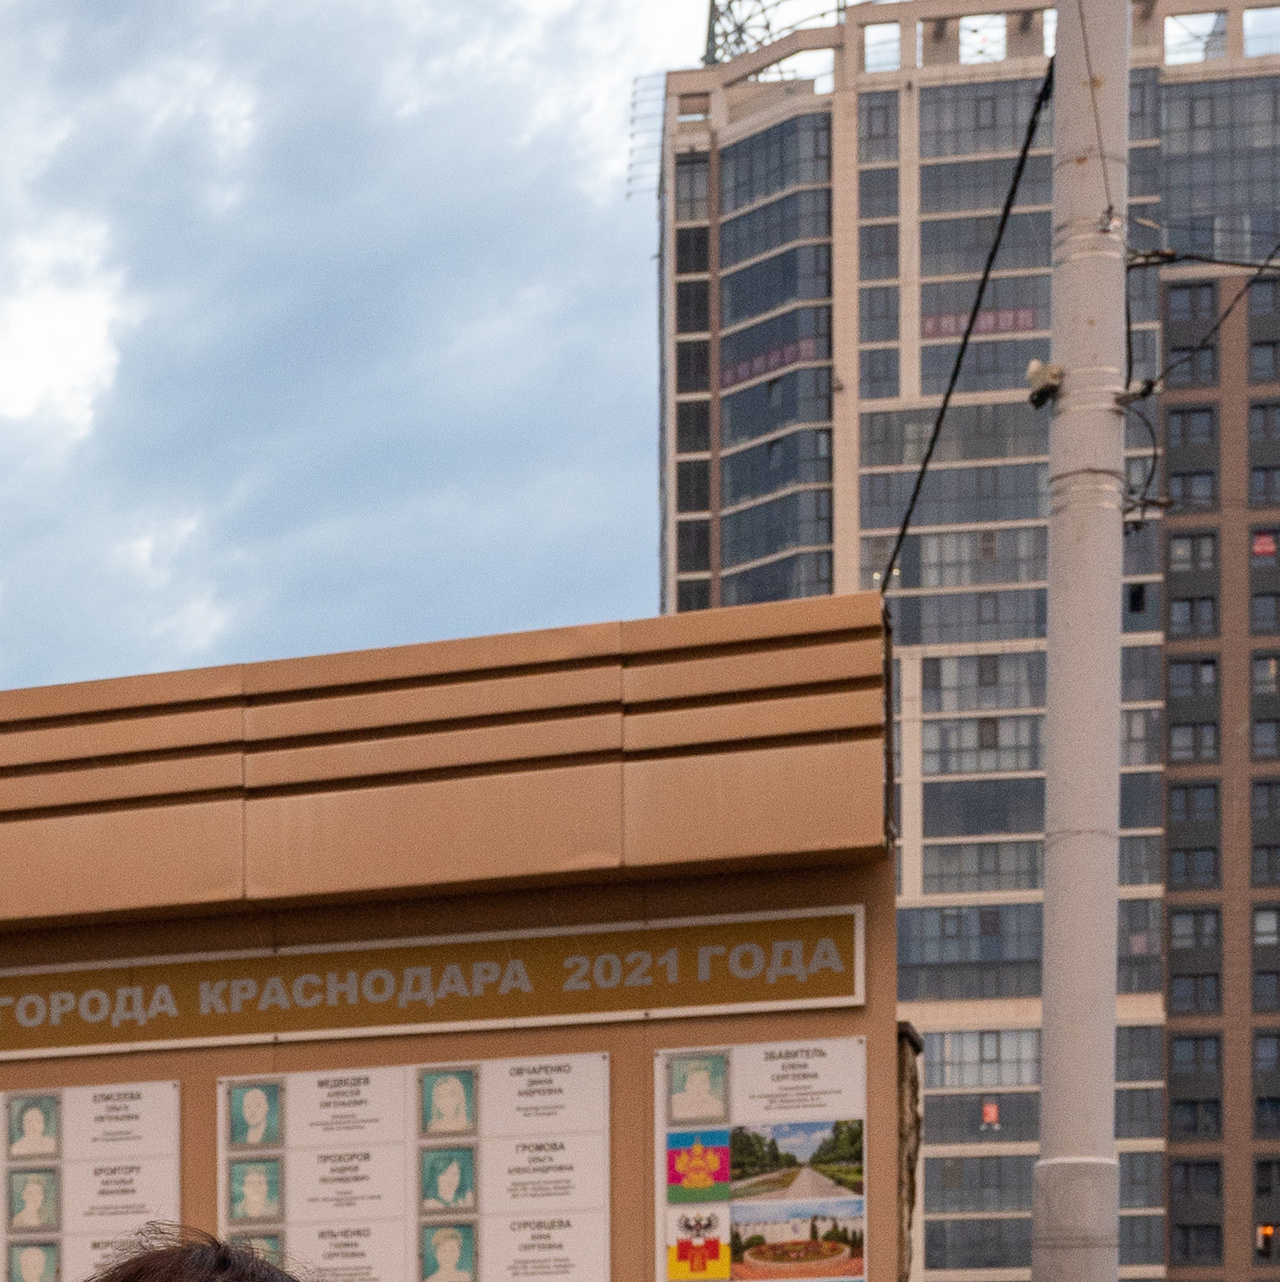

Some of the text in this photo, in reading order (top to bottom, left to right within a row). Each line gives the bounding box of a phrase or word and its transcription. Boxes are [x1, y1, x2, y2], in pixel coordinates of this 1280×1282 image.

[198, 960, 532, 1015] КРАСНОДАРА
[562, 948, 680, 991] 2021
[697, 937, 845, 983] ГОДА
